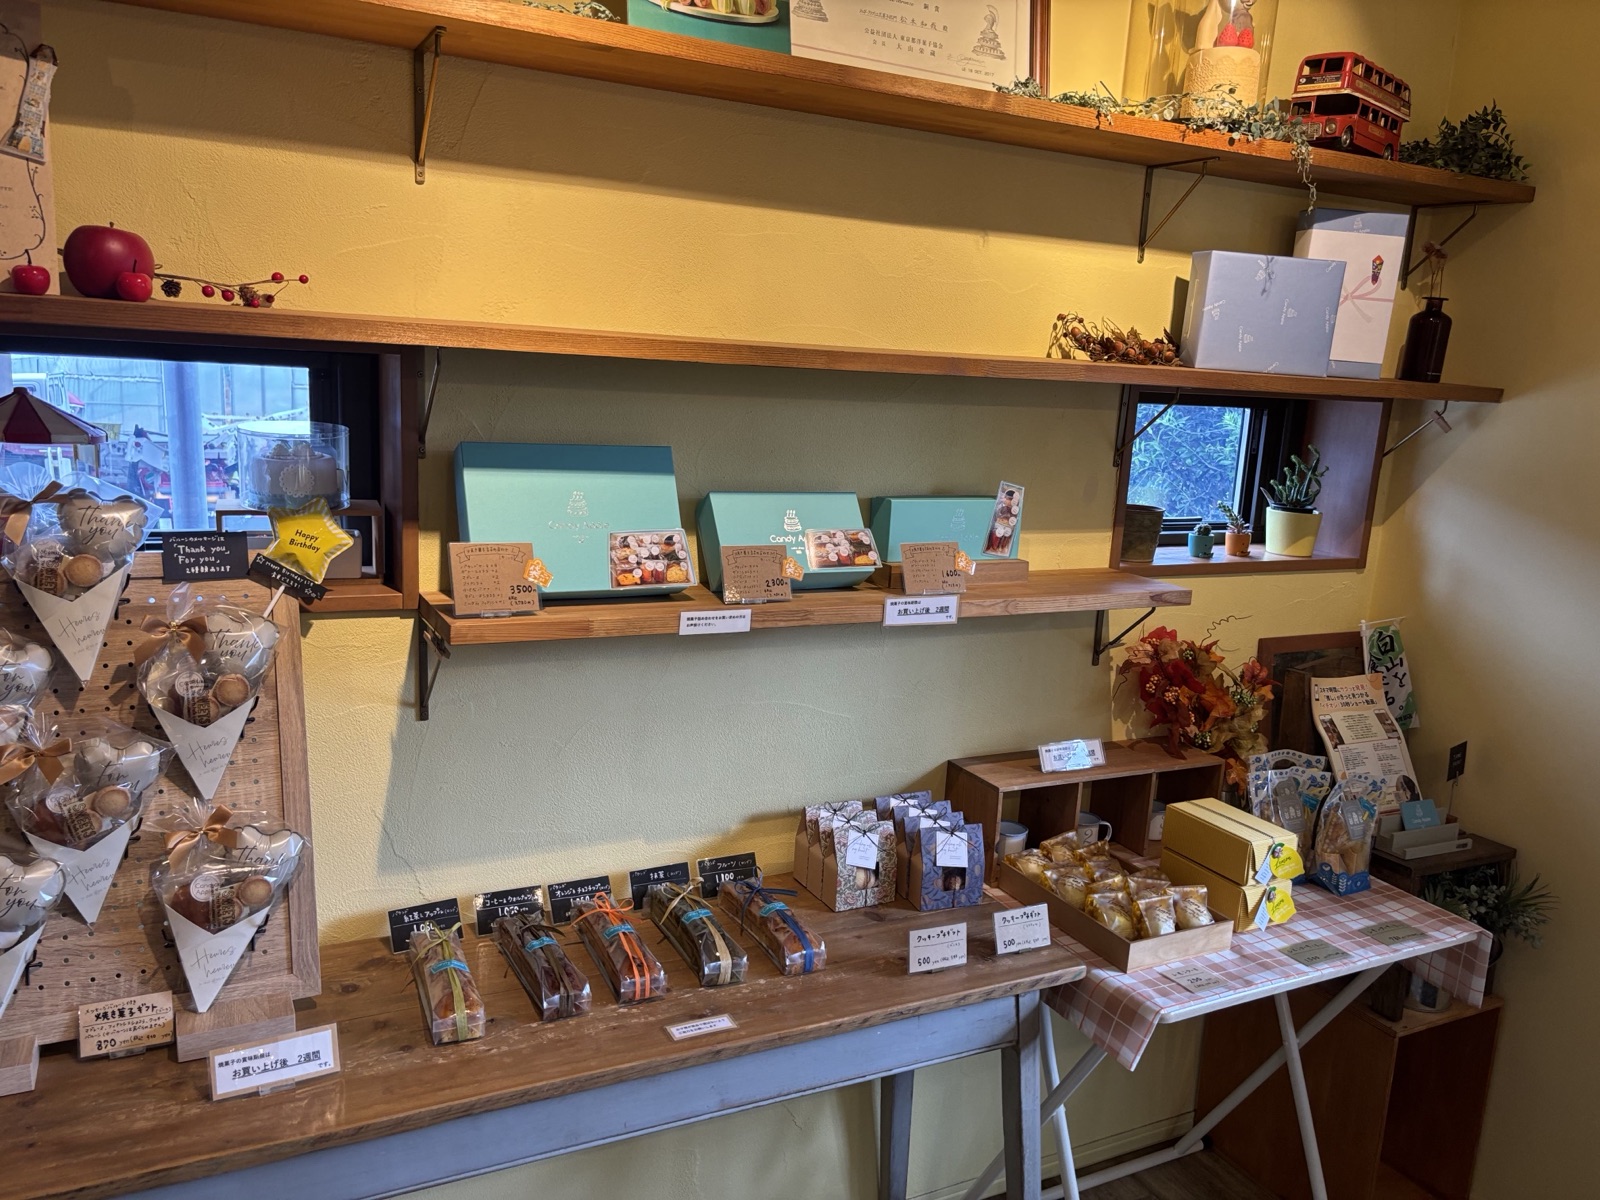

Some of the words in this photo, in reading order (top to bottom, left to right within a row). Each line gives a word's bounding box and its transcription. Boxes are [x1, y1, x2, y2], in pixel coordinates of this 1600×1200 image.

[82, 526, 120, 546] you
[294, 529, 320, 542] Happy
[769, 534, 796, 544] Candy
[288, 536, 321, 554] Birthday
[897, 607, 931, 616] お買い上げ後
[935, 605, 950, 614] 2週間
[1084, 828, 1094, 844] 2
[1003, 938, 1016, 949] 500
[917, 956, 931, 967] 500
[94, 1002, 158, 1021] 焼き菓子ギフト
[96, 1038, 117, 1051] 870
[232, 1058, 289, 1079] お買い上げ後
[297, 1050, 321, 1064] 2週間
